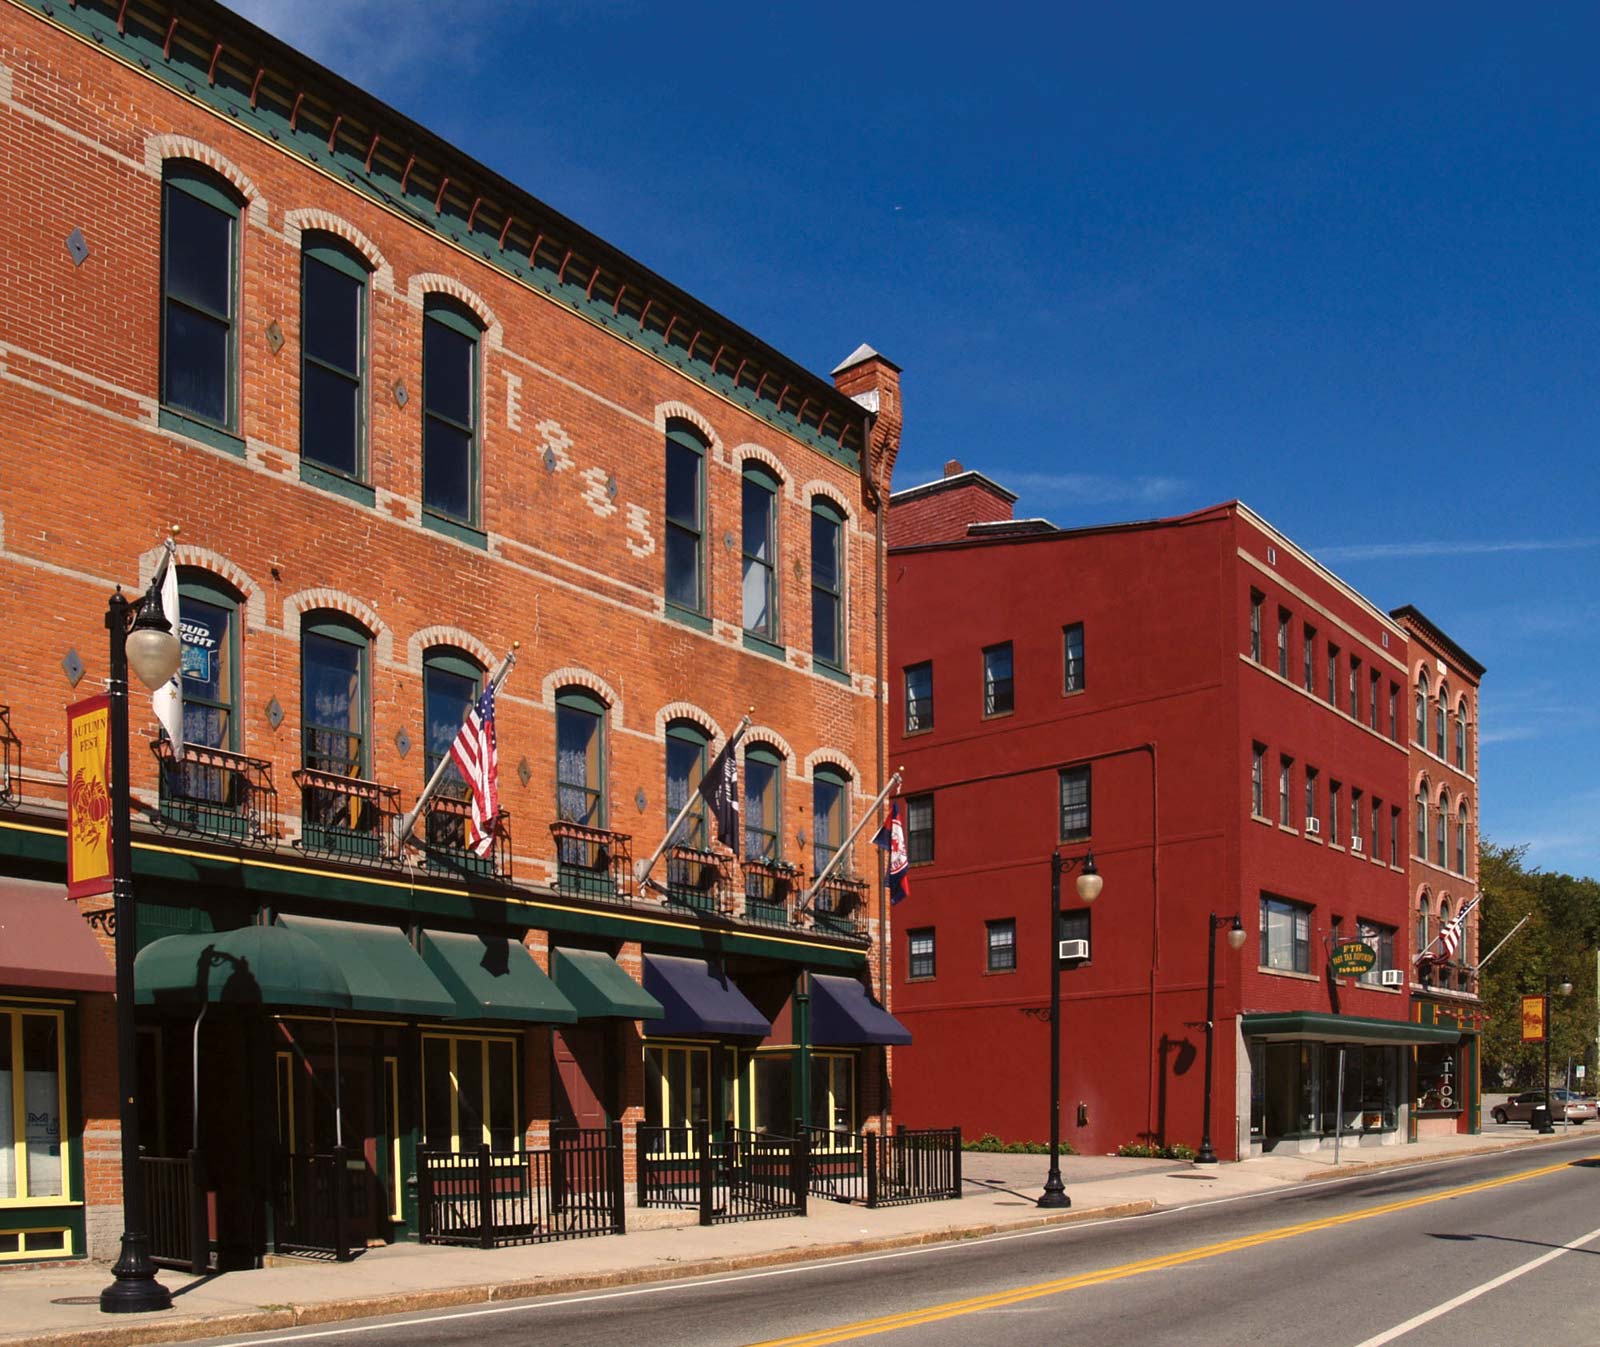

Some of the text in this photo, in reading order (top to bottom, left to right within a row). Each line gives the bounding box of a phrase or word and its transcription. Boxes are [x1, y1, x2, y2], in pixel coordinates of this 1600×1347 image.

[180, 632, 216, 648] GHT
[73, 717, 106, 738] AUTUMN
[80, 736, 98, 752] FEST
[1343, 945, 1362, 953] FTR
[1440, 1056, 1453, 1108] TTOO
